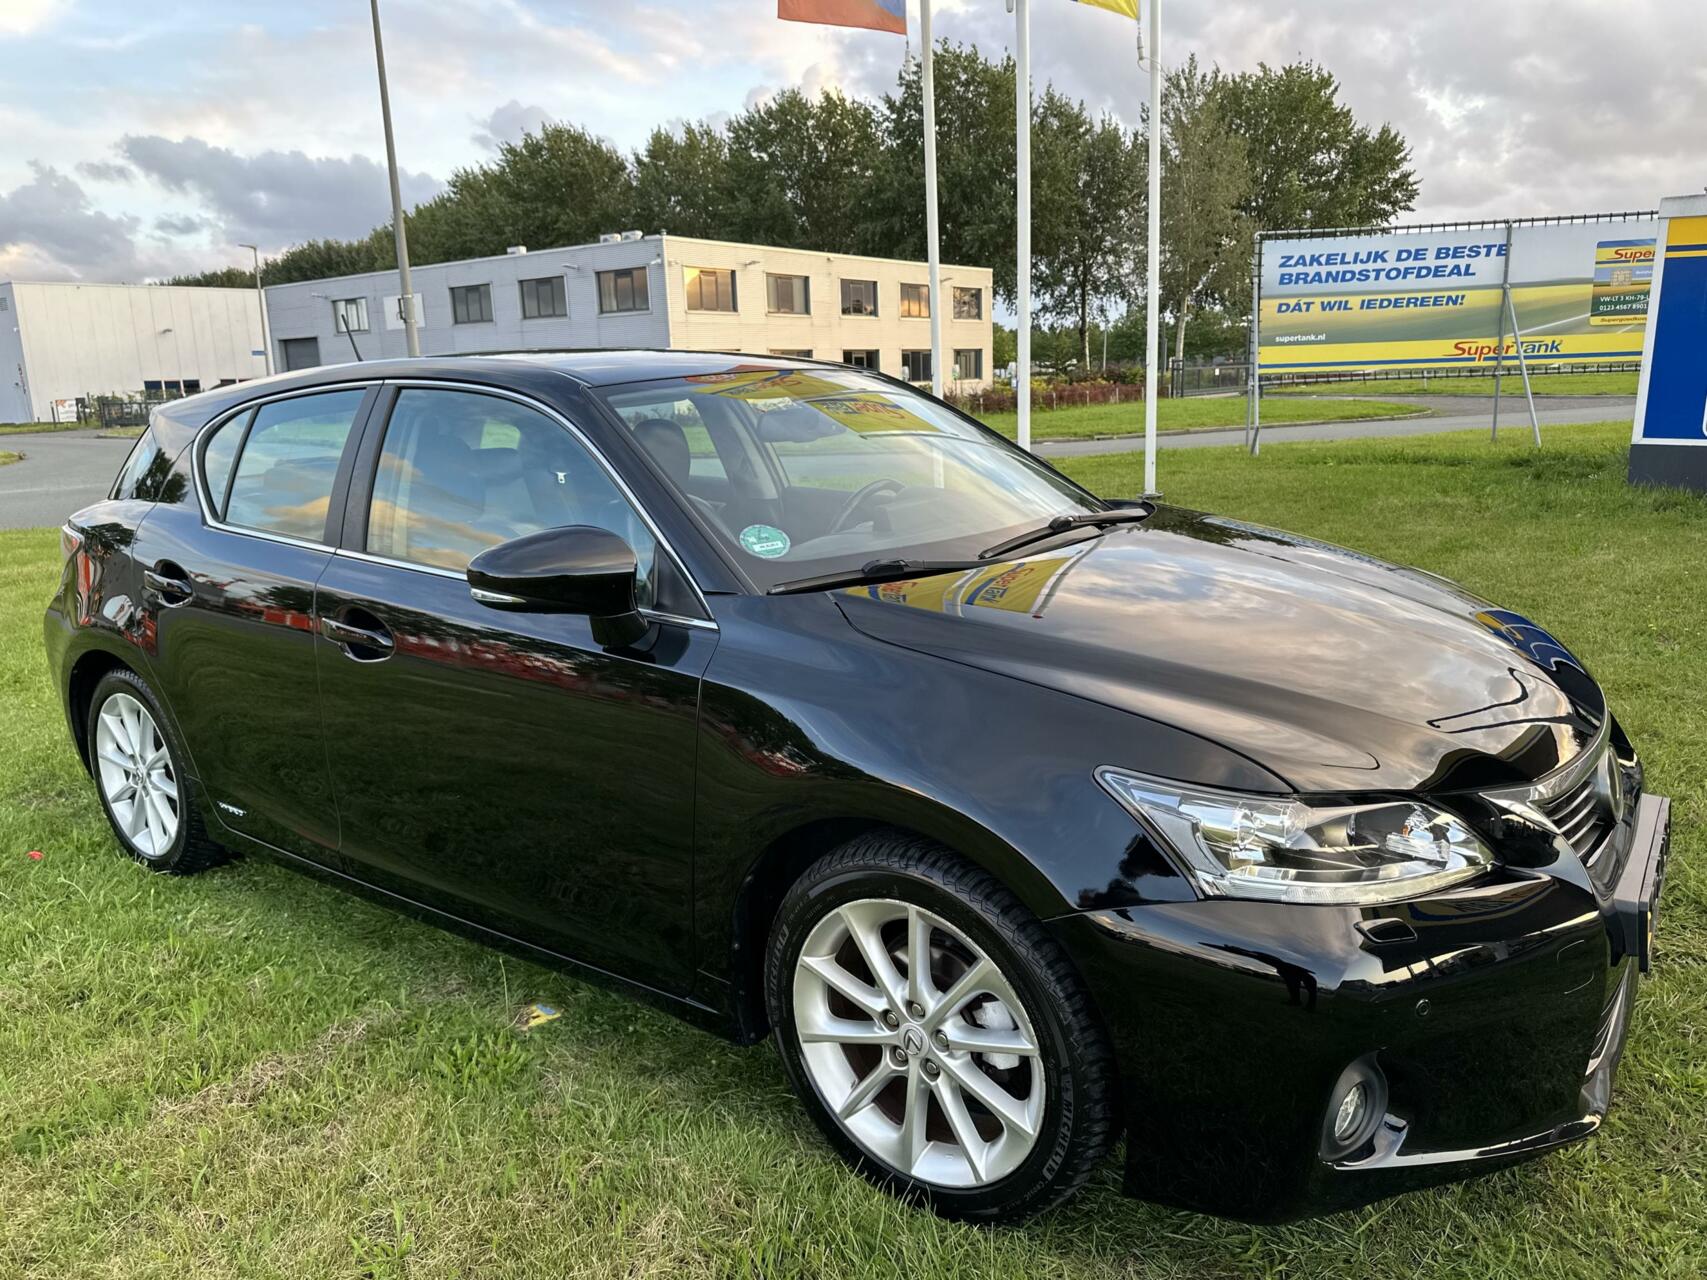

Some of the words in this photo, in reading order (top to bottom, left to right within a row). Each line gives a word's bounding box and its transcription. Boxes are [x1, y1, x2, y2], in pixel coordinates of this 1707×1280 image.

[1278, 250, 1390, 269] ZAKELIJK
[1395, 247, 1429, 263] DE
[1434, 243, 1508, 260] BESTE
[1278, 263, 1477, 286] BRANDSTOFDEAL
[1276, 299, 1315, 314] DÁT
[1319, 299, 1354, 313] WIL
[1359, 294, 1467, 311] IEDEREEN!
[1275, 332, 1327, 344] supertank.nl
[1044, 1098, 1074, 1180] MICHELIN
